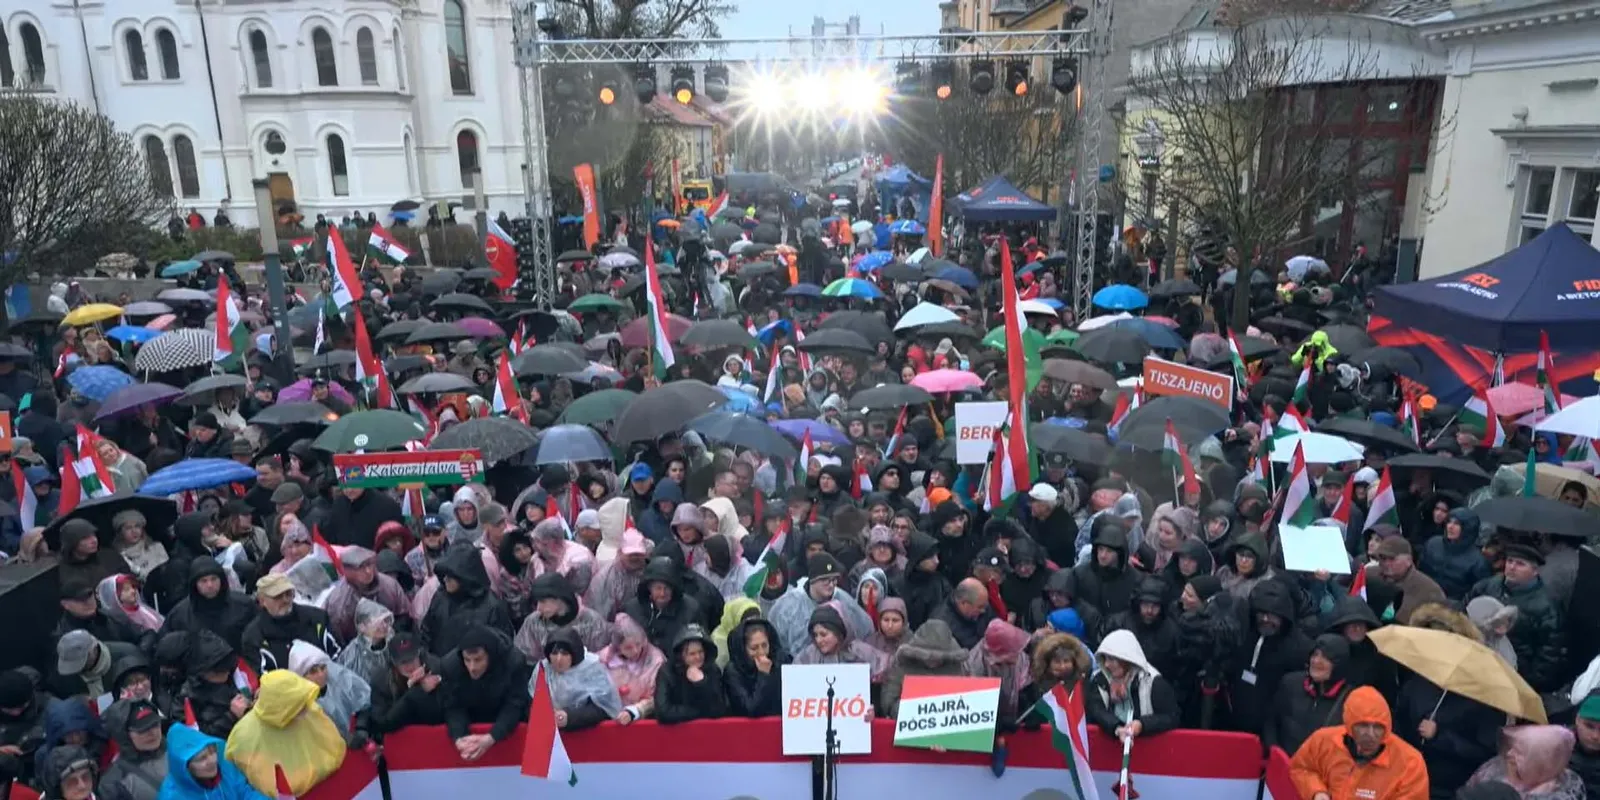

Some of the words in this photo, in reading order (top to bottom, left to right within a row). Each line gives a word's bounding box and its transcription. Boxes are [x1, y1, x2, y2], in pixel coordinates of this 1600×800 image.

[960, 426, 998, 441] BER
[788, 694, 866, 718] BERKÓ
[917, 695, 969, 715] HAJRÁ,
[898, 715, 937, 732] PÓCS
[939, 710, 995, 728] JÁNOS!
